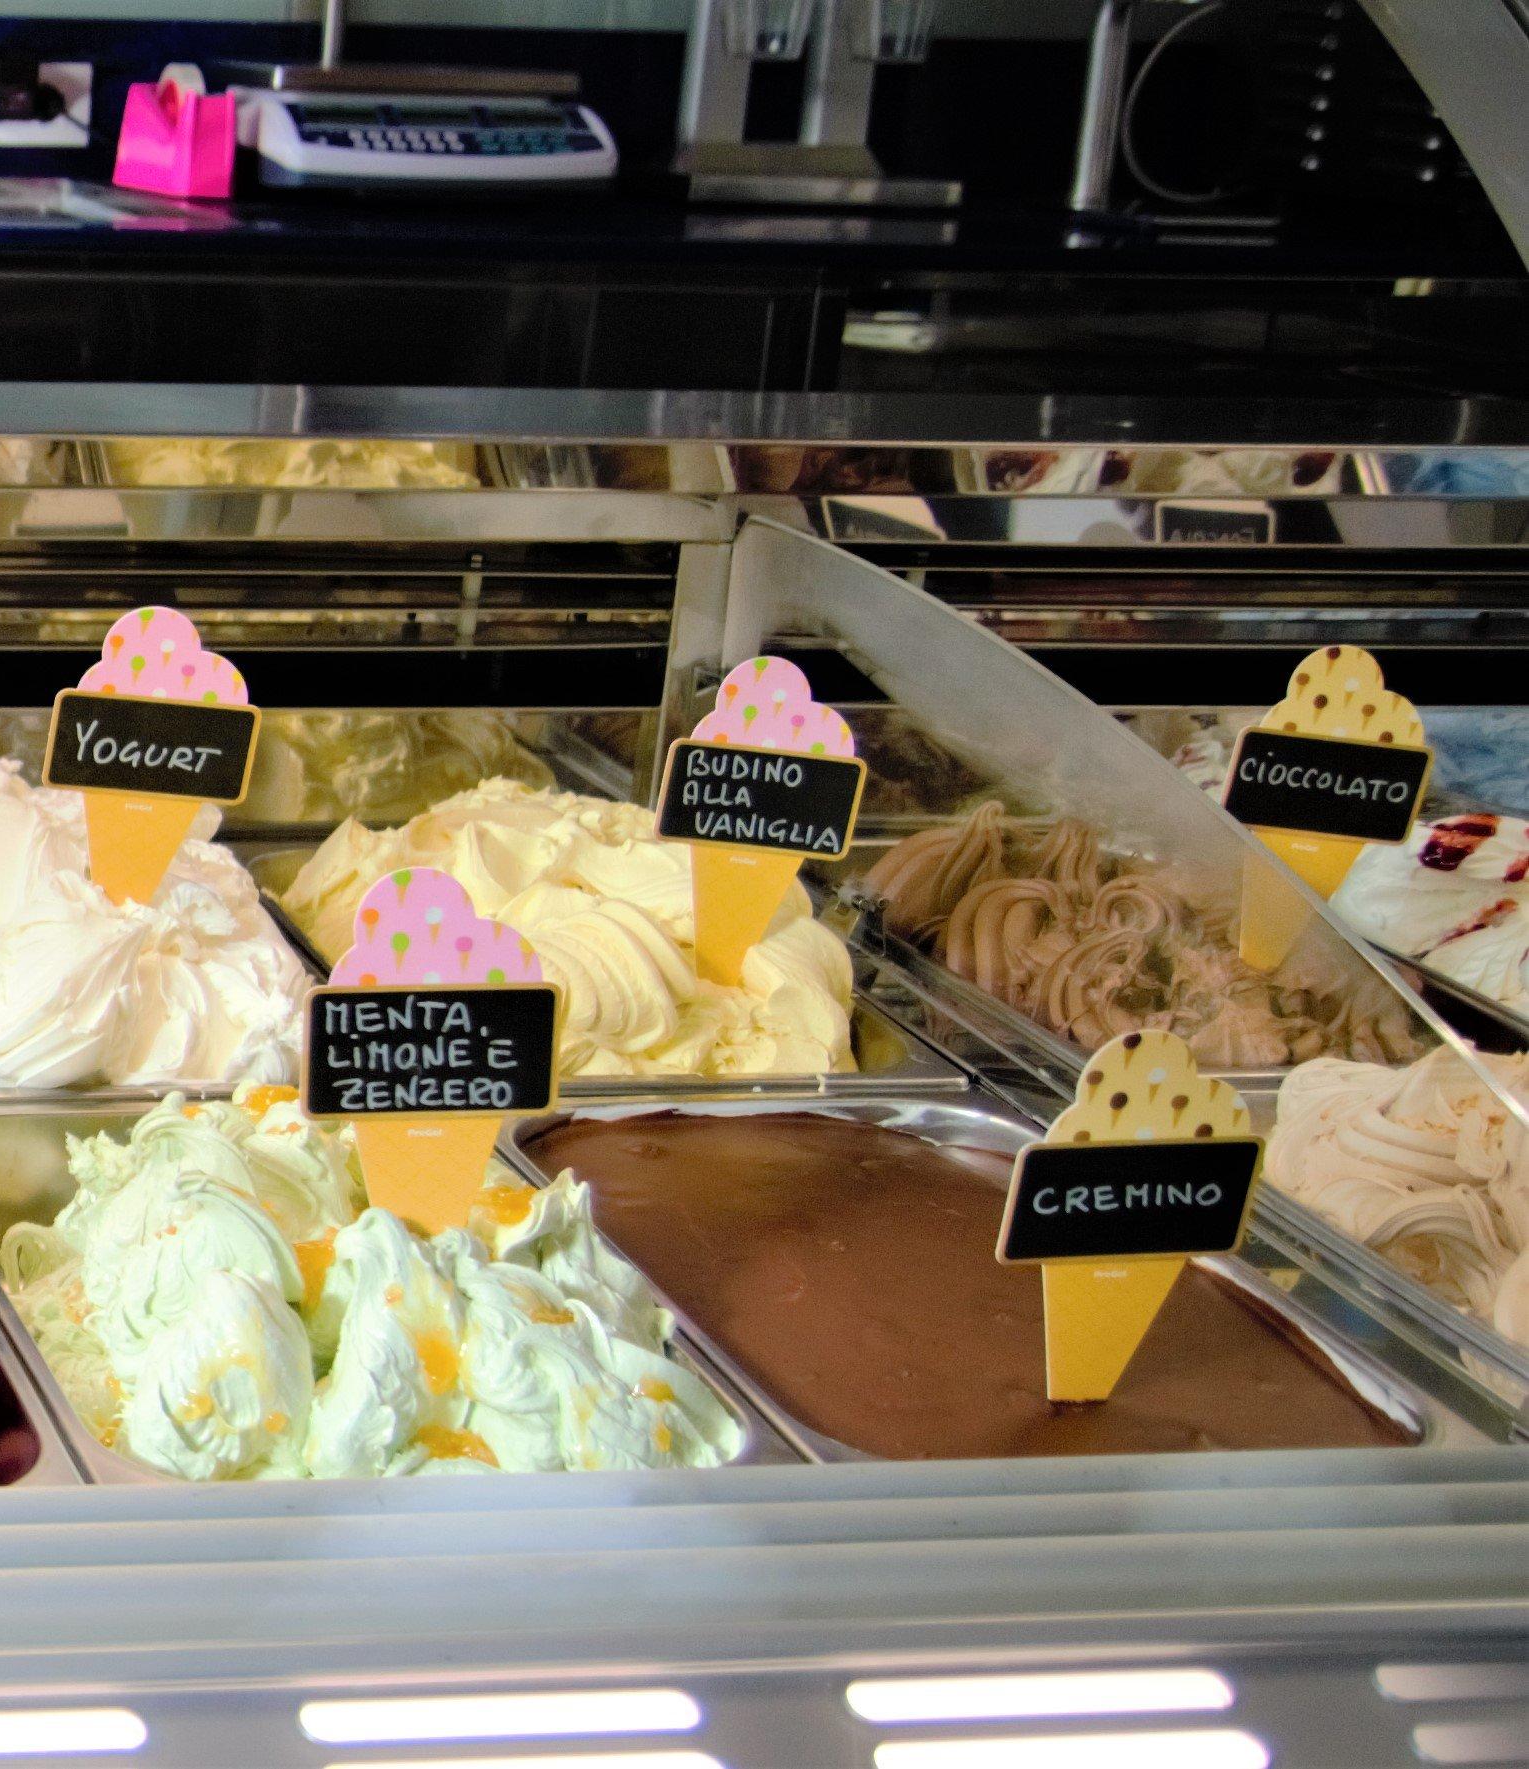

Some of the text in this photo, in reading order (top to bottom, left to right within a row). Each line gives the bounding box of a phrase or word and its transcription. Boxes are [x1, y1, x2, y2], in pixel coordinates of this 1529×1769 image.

[76, 719, 223, 773] YOGURT
[686, 749, 803, 788] BUDINO
[682, 780, 752, 808] ALLA
[695, 810, 841, 853] VANIGLIA
[487, 1039, 518, 1070] E
[332, 1074, 513, 1110] ZENZERO
[1032, 1182, 1223, 1216] CREMINO
